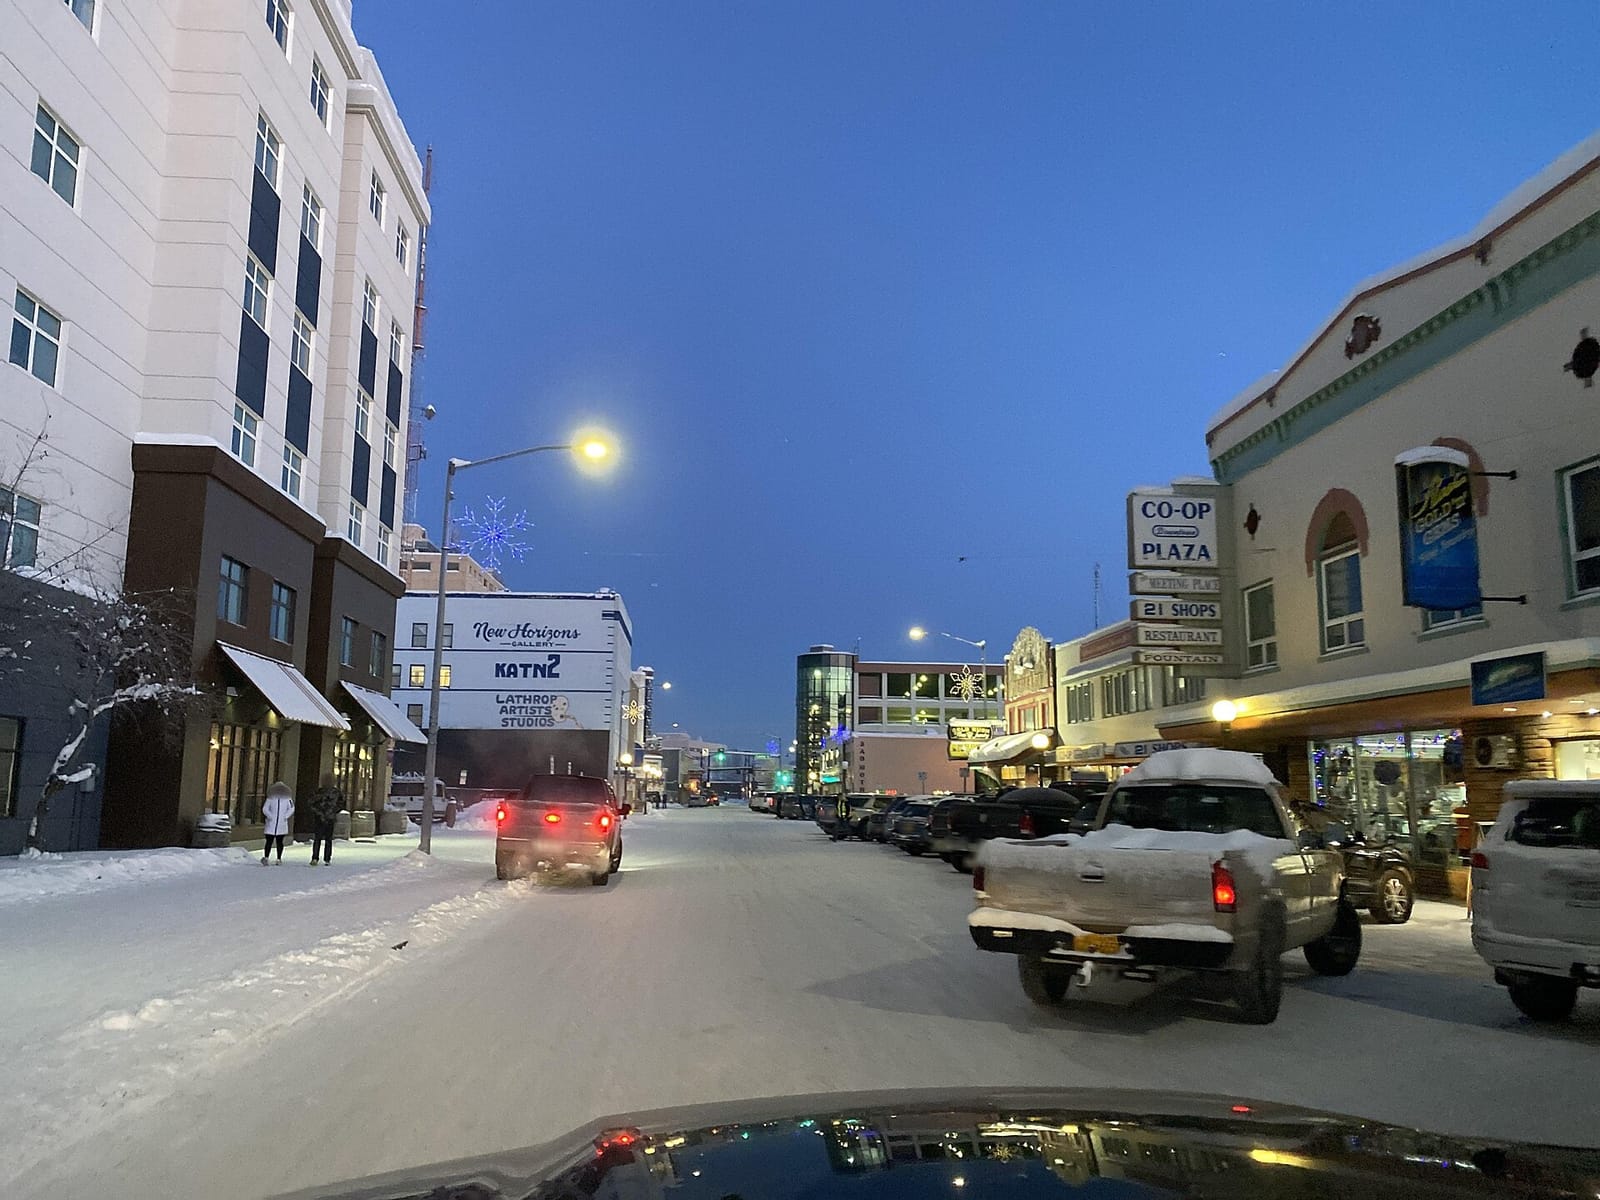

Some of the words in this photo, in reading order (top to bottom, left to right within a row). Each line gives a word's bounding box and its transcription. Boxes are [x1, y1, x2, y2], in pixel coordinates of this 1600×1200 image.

[1141, 501, 1211, 519] CO-OP
[1142, 543, 1211, 561] PLAZA
[1149, 577, 1190, 589] MEETING
[1144, 603, 1163, 616] 21
[1171, 603, 1216, 617] SHOPS
[473, 621, 507, 642] New
[507, 622, 581, 639] Horizons
[1144, 630, 1218, 642] RESTAURANT
[511, 640, 555, 648] GALLERY
[1144, 654, 1218, 663] FOUNTAIN
[496, 694, 557, 704] LATHROP
[499, 705, 553, 715] ARTISTS
[501, 716, 555, 728] STUDIOS
[1134, 744, 1147, 755] 21
